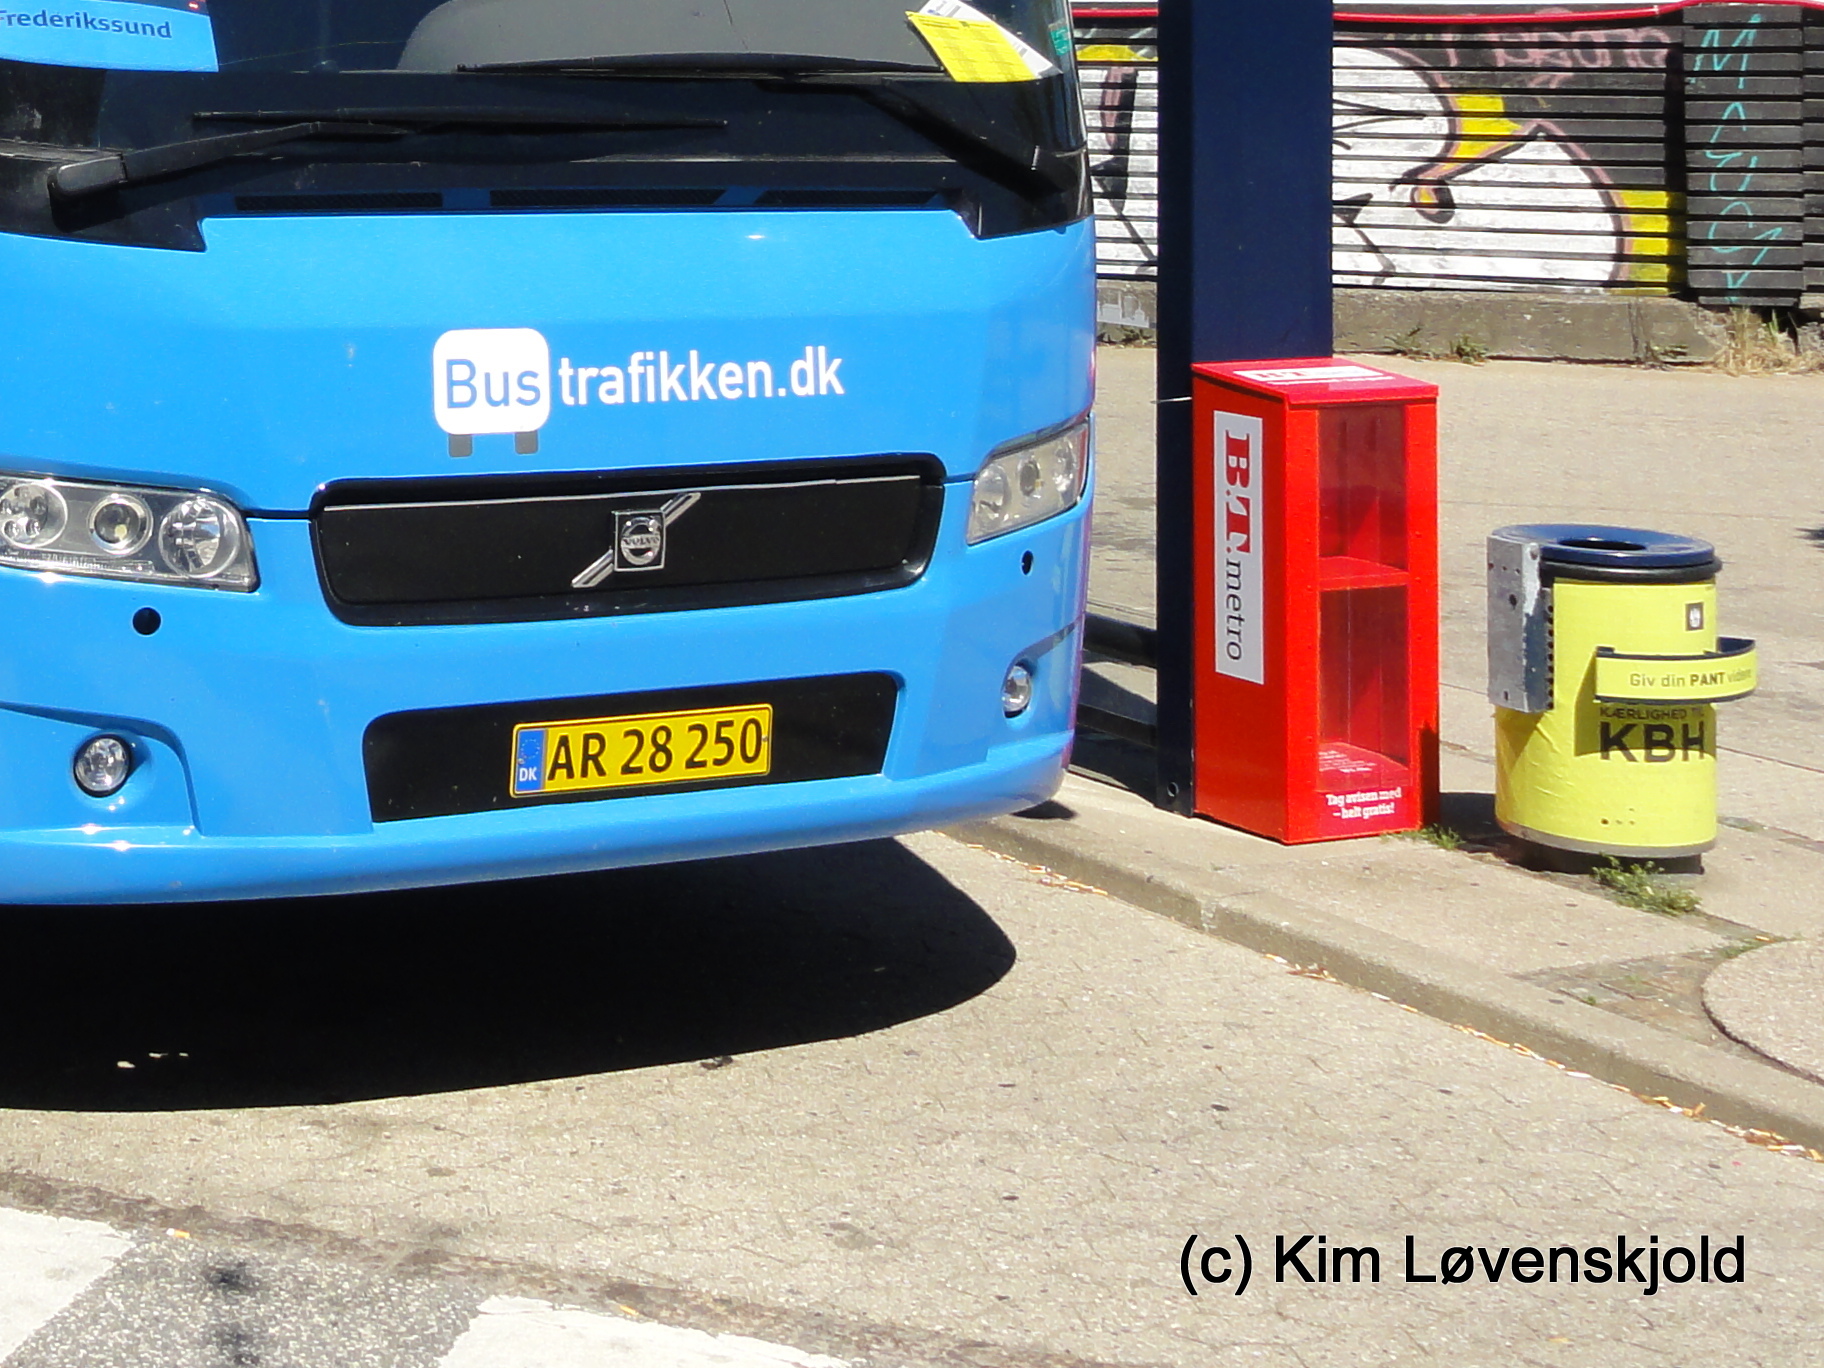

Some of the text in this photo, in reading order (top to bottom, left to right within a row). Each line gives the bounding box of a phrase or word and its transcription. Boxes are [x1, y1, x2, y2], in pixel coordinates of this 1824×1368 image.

[445, 345, 846, 409] Bus trafikken.dk
[622, 535, 660, 546] VOLVO
[1225, 557, 1246, 661] metro
[1630, 674, 1656, 687] Giv
[1661, 674, 1685, 688] din
[1690, 672, 1725, 687] PANT
[1600, 706, 1688, 720] KÆRLIGHED
[547, 717, 763, 782] AR 28 250
[1600, 721, 1705, 763] KBH
[519, 767, 537, 782] DK
